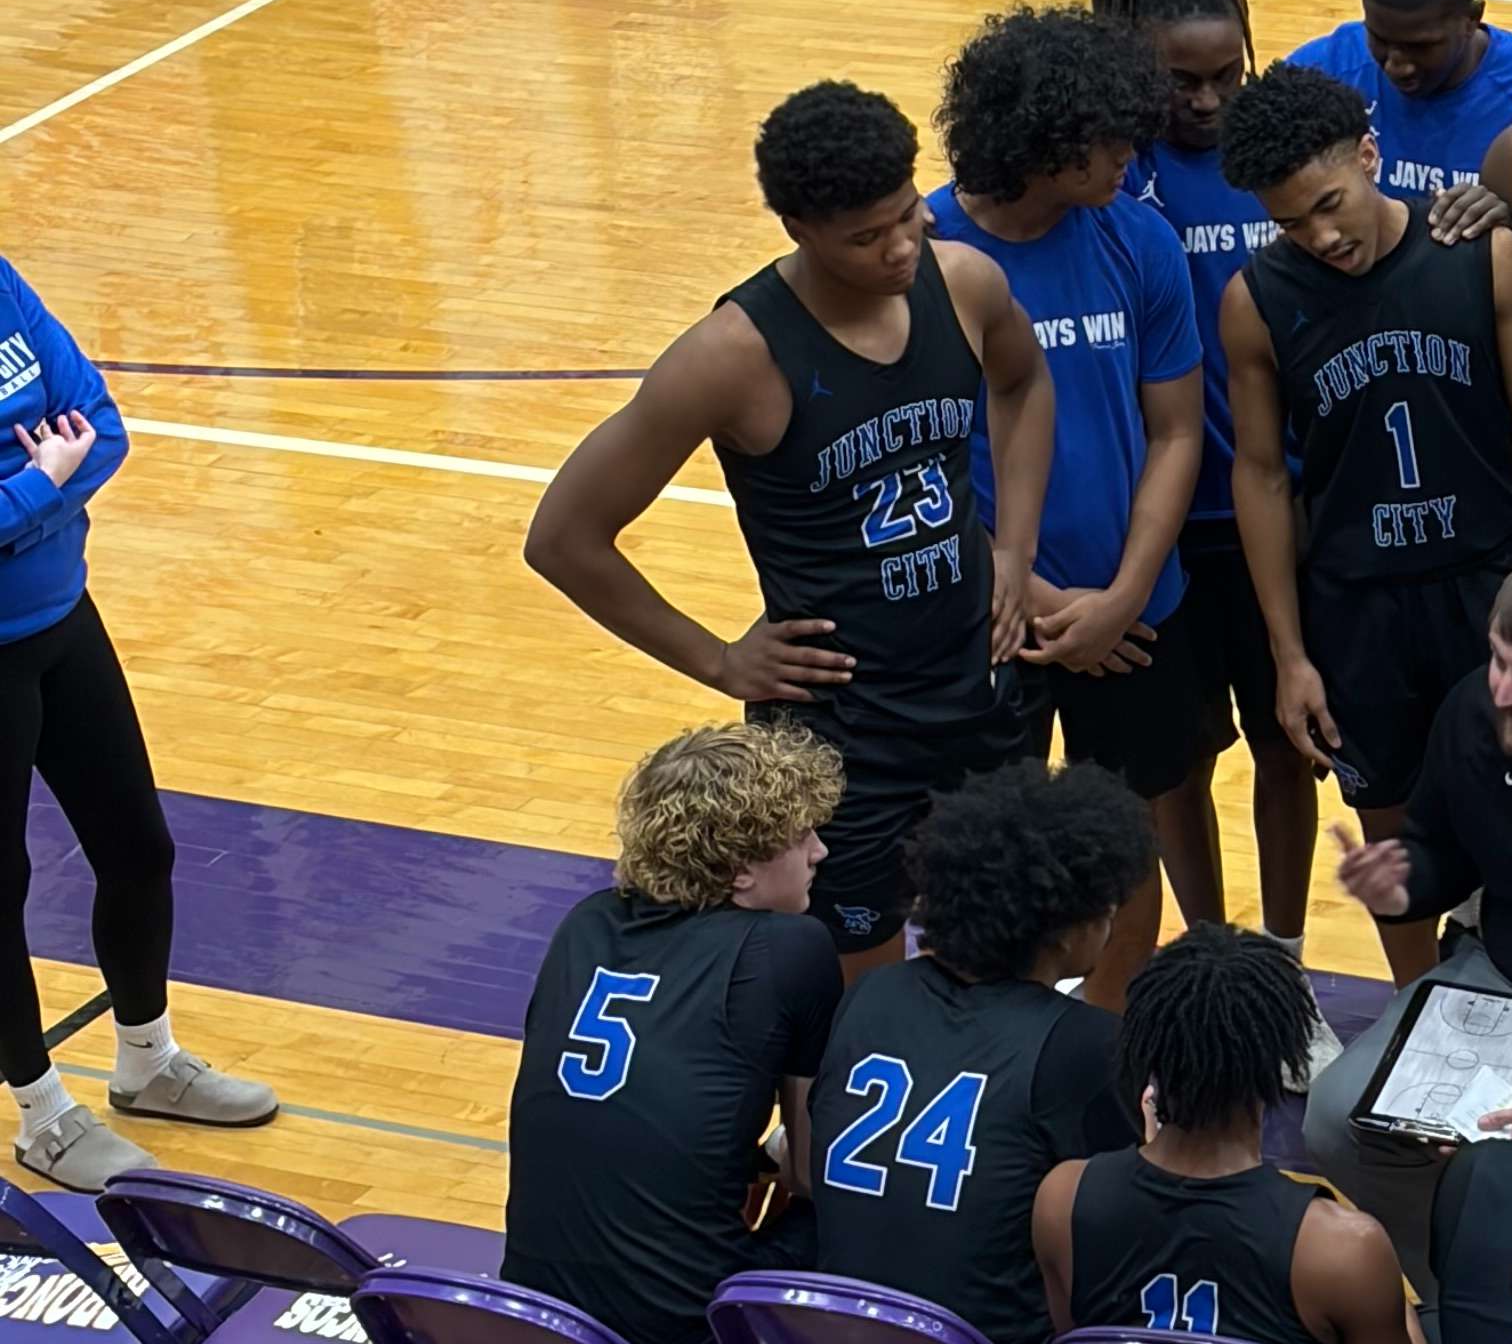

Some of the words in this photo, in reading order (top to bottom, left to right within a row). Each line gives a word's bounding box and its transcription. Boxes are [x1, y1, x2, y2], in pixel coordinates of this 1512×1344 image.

[1389, 160, 1444, 191] JAYS
[1183, 223, 1235, 253] JAYS
[1082, 311, 1125, 343] WIN
[1313, 330, 1472, 416] JUNCTION
[810, 398, 973, 493] JUNCTION
[1384, 401, 1420, 488] 1
[853, 453, 953, 548] 23
[1372, 495, 1456, 547] CITY
[881, 534, 962, 600] CITY
[557, 966, 660, 1101] 5
[824, 1053, 988, 1212] 24
